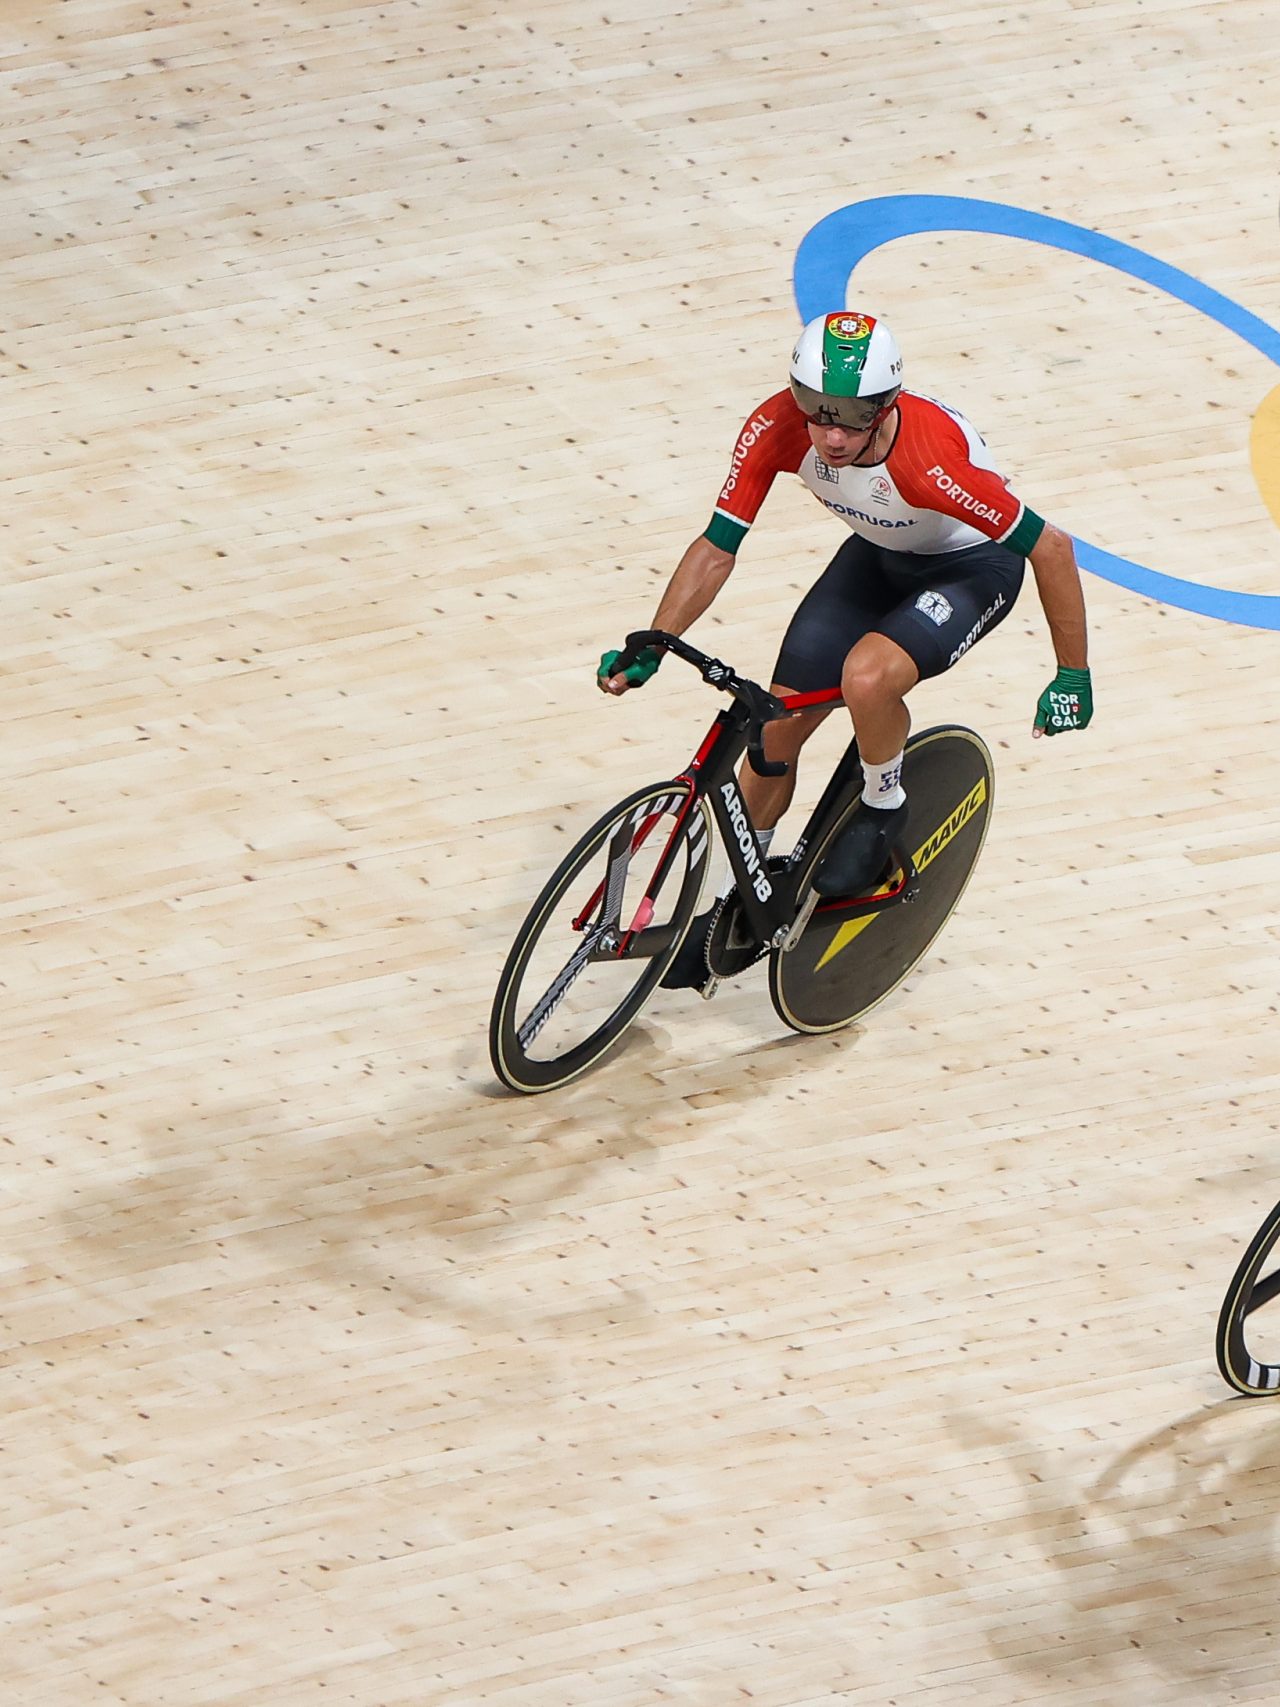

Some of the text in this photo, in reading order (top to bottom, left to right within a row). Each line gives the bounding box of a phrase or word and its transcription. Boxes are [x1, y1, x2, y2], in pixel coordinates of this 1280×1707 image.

[720, 413, 775, 500] PORTUGAL
[823, 498, 919, 528] PORTUGAL
[926, 465, 1003, 526] PORTUGAL
[948, 592, 1006, 666] PORTUGAL
[1049, 691, 1079, 705] POR
[1051, 714, 1081, 727] GAL
[1052, 703, 1070, 716] TU
[721, 782, 773, 903] ARGON 18
[917, 785, 982, 870] MAVIC
